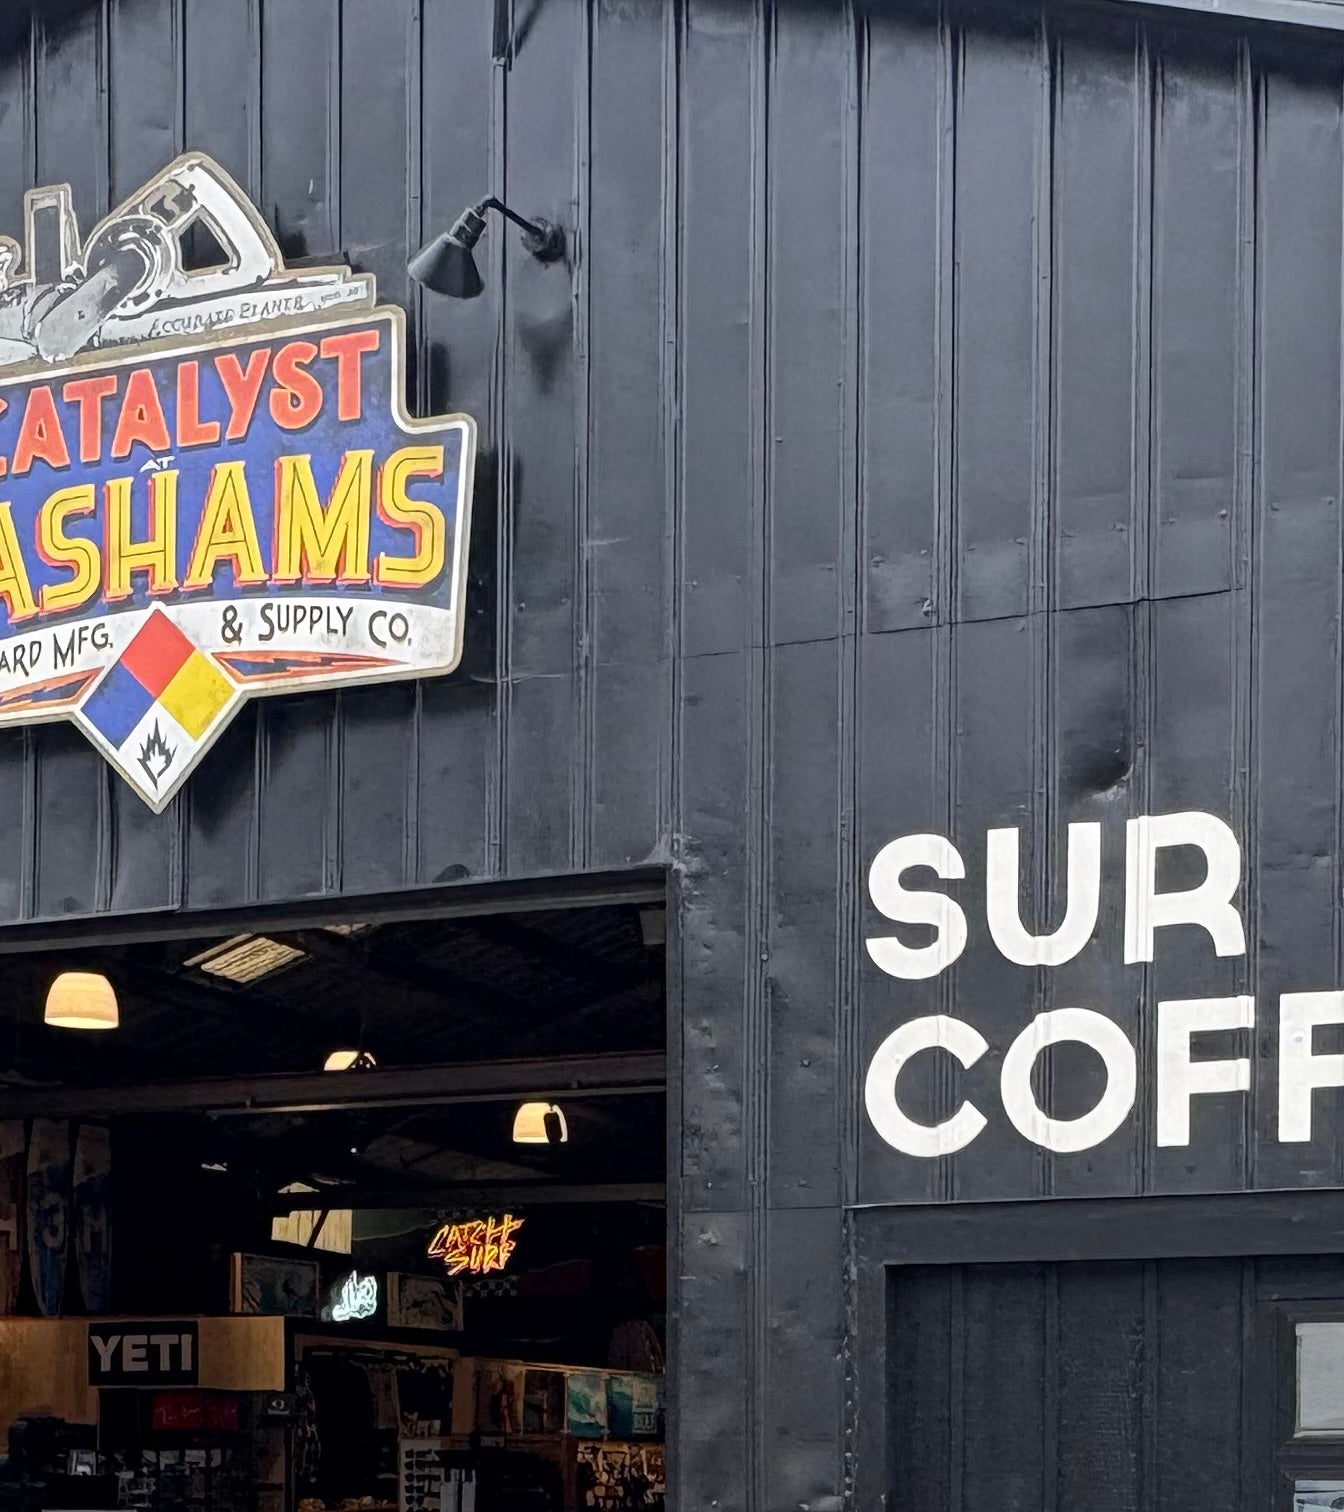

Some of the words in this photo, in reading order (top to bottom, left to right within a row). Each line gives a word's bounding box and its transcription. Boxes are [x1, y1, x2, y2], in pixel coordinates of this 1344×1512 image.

[139, 455, 176, 473] AT
[52, 622, 114, 670] MFG.
[220, 604, 244, 647] &
[258, 602, 354, 642] SUPPLY
[368, 609, 412, 649] CO.
[865, 810, 1247, 980] SUR
[90, 1334, 193, 1373] YETI
